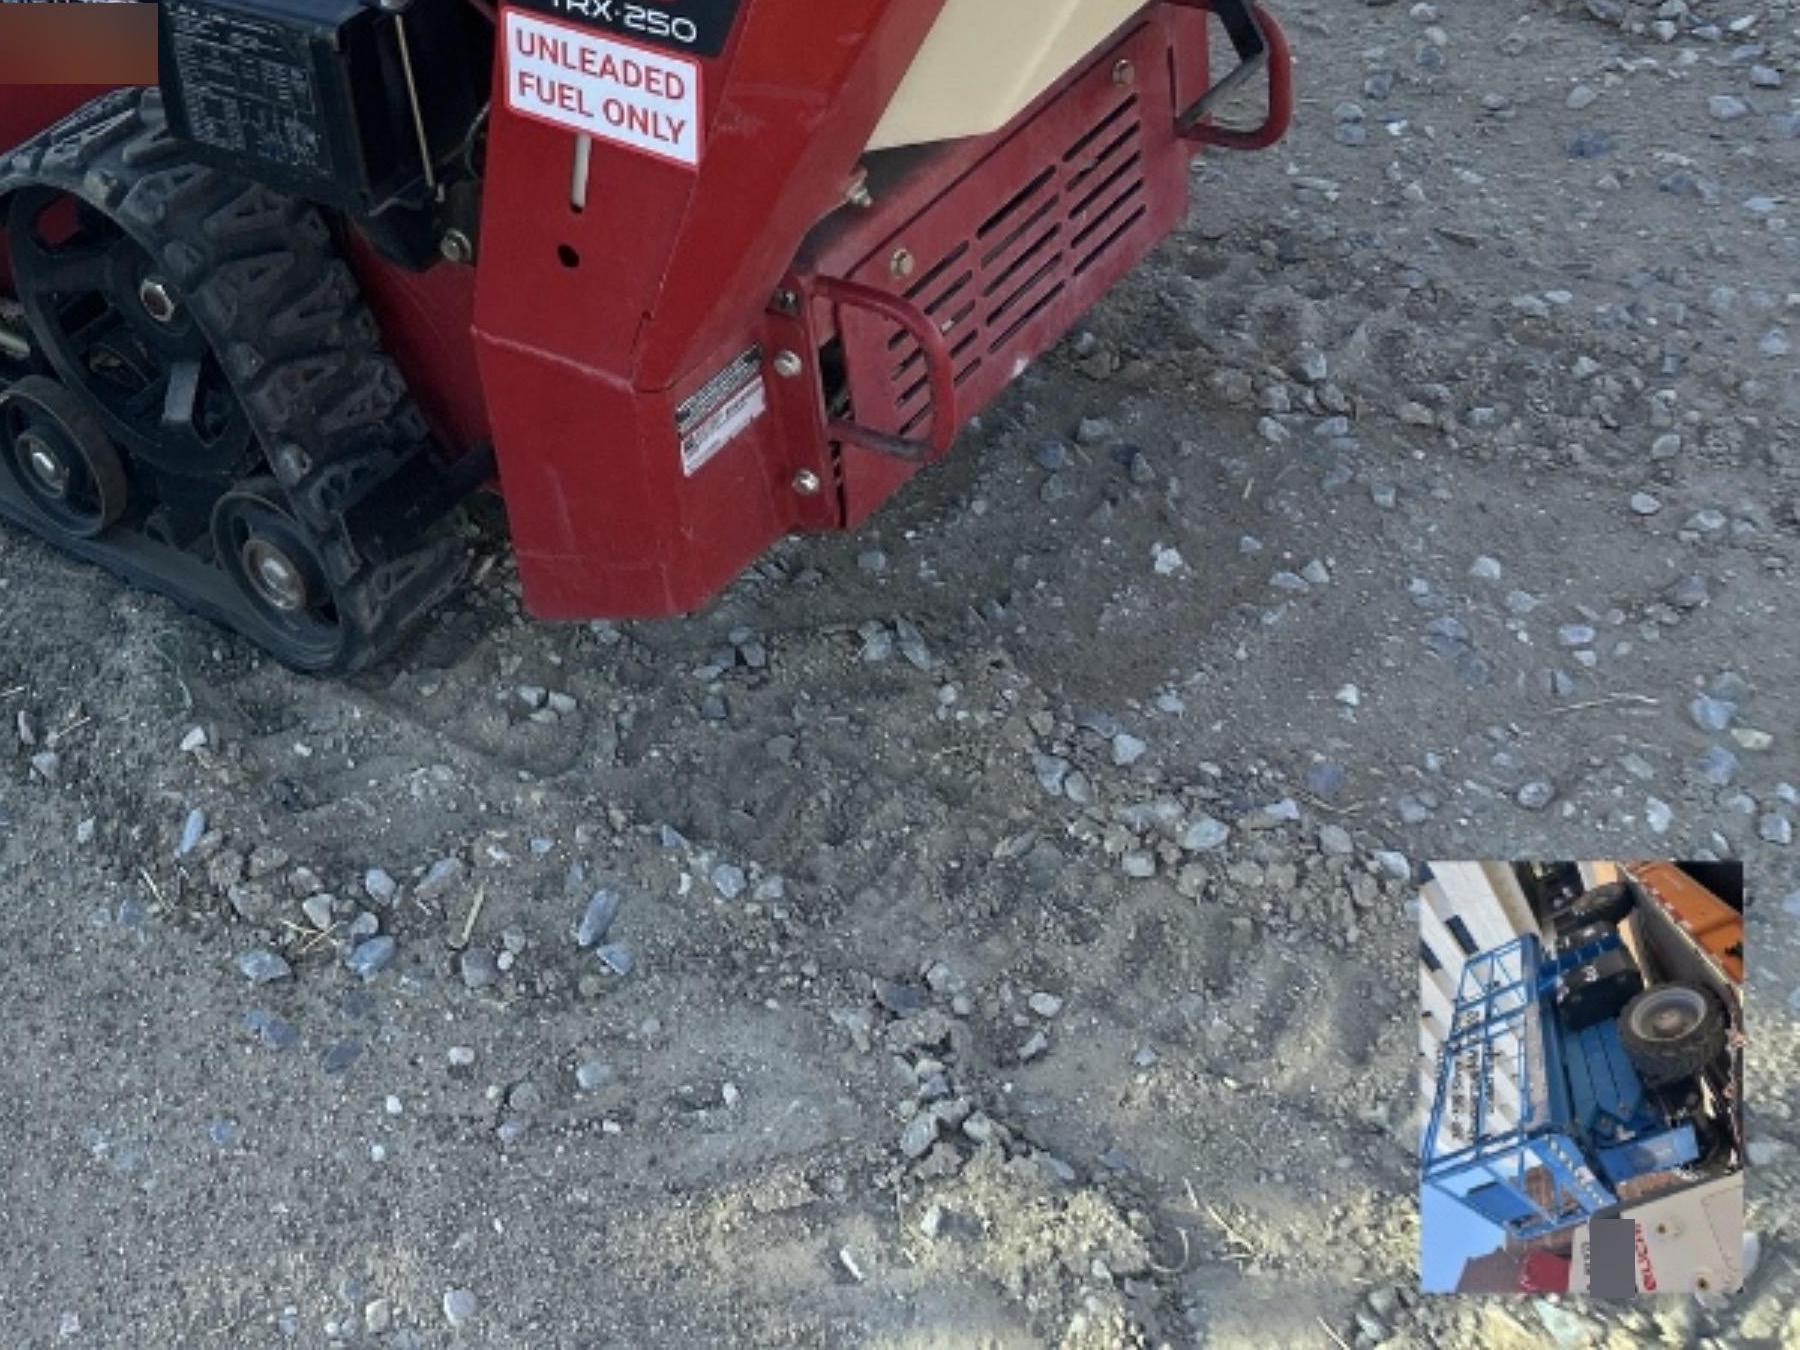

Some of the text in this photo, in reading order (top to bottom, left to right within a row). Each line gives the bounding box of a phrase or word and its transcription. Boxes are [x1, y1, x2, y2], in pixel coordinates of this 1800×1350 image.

[516, 29, 685, 99] UNLEADED
[517, 71, 686, 145] FUEL ONLY
